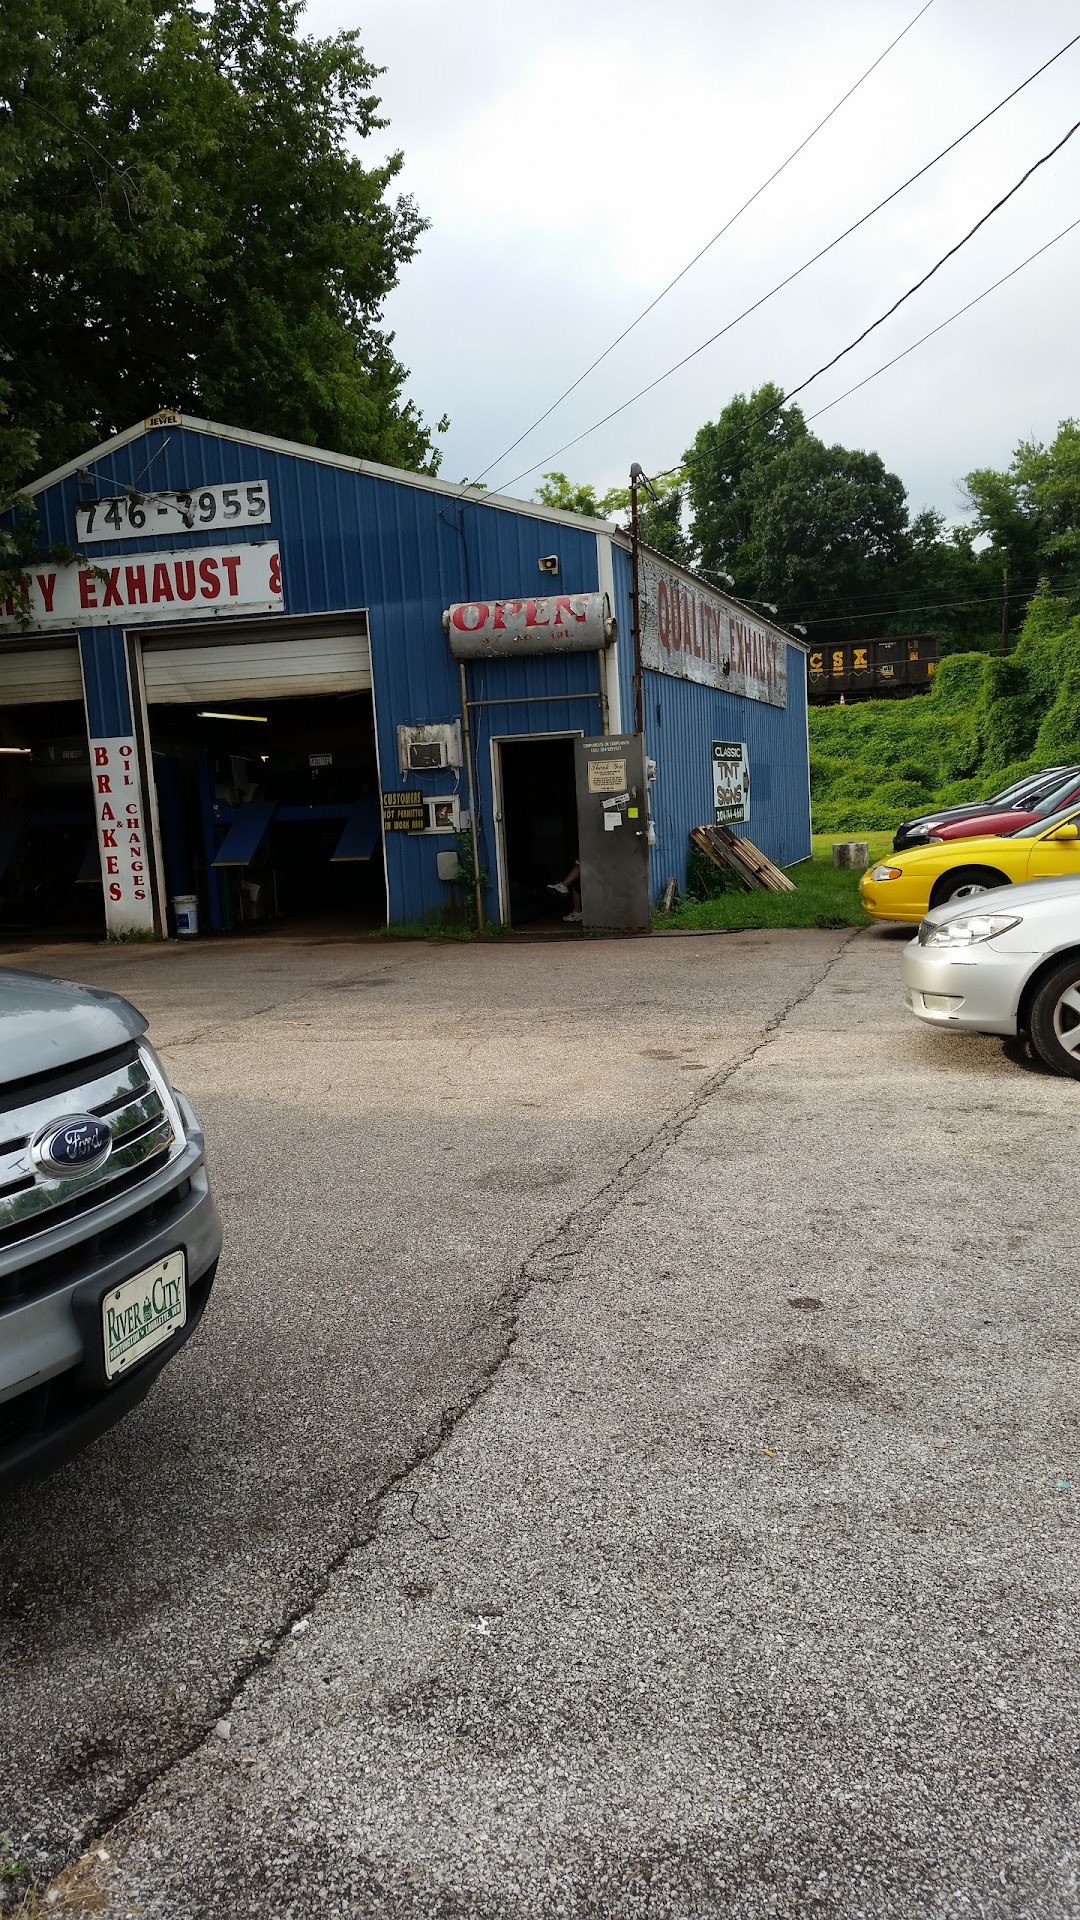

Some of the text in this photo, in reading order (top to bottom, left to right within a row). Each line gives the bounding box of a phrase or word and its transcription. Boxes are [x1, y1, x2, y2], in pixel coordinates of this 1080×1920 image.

[150, 416, 177, 426] JEWEL
[81, 486, 267, 534] 746-7955
[78, 555, 241, 609] EXHAUST
[452, 594, 589, 632] OPEN
[657, 579, 778, 689] QUALITY EXHAUST
[809, 648, 868, 669] CSX
[714, 746, 742, 758] CLASSIC
[590, 763, 609, 771] Thank
[383, 791, 421, 806] CUSTOMERS
[716, 784, 742, 806] SIGNS
[93, 746, 122, 902] BRAKES
[116, 820, 124, 828] &
[118, 745, 146, 901] OIL CHANGES
[383, 807, 424, 819] NOT PERMITTED
[393, 820, 410, 830] WORK
[411, 819, 424, 829] AREA
[64, 1125, 103, 1160] Ford
[106, 1276, 182, 1349] RIVER CITY
